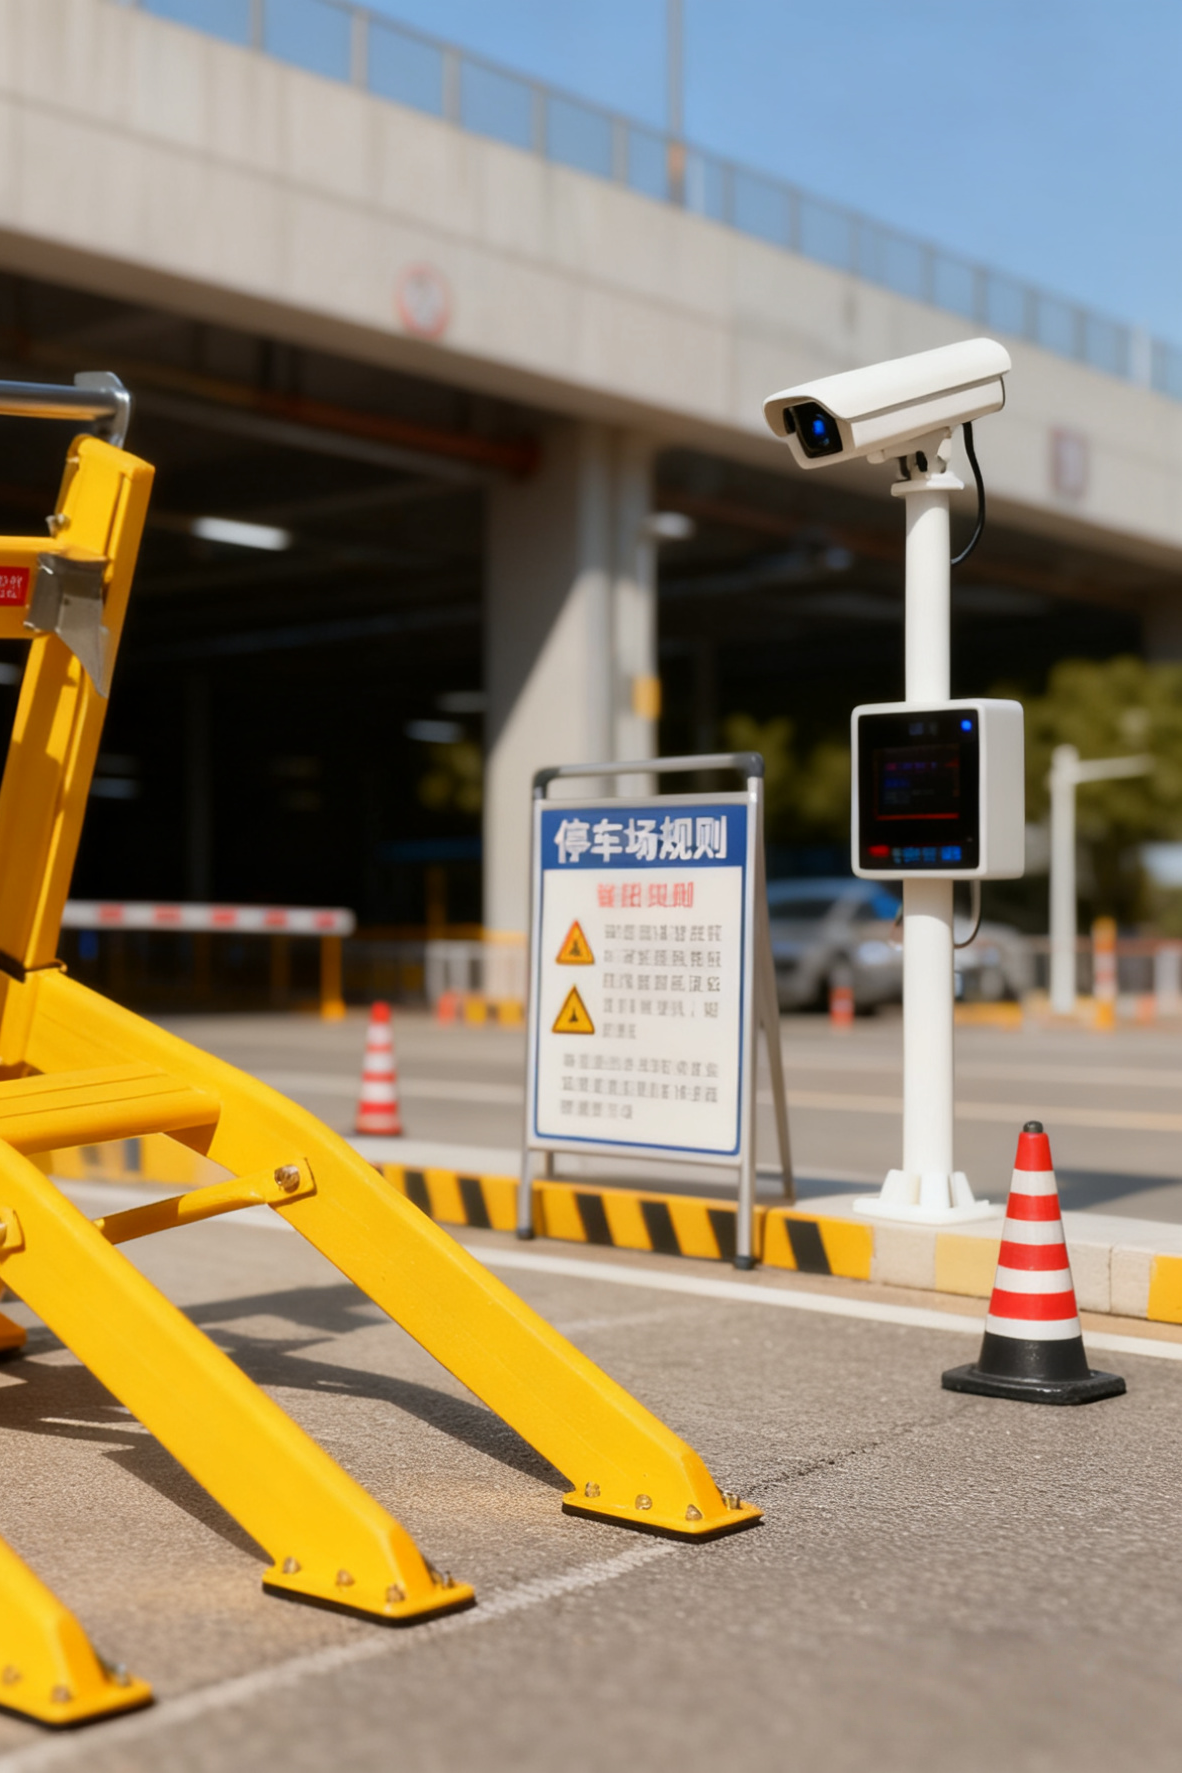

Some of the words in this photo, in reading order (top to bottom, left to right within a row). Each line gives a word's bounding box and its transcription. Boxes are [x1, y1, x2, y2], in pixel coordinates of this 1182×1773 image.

[554, 815, 727, 864] 停车场规则
